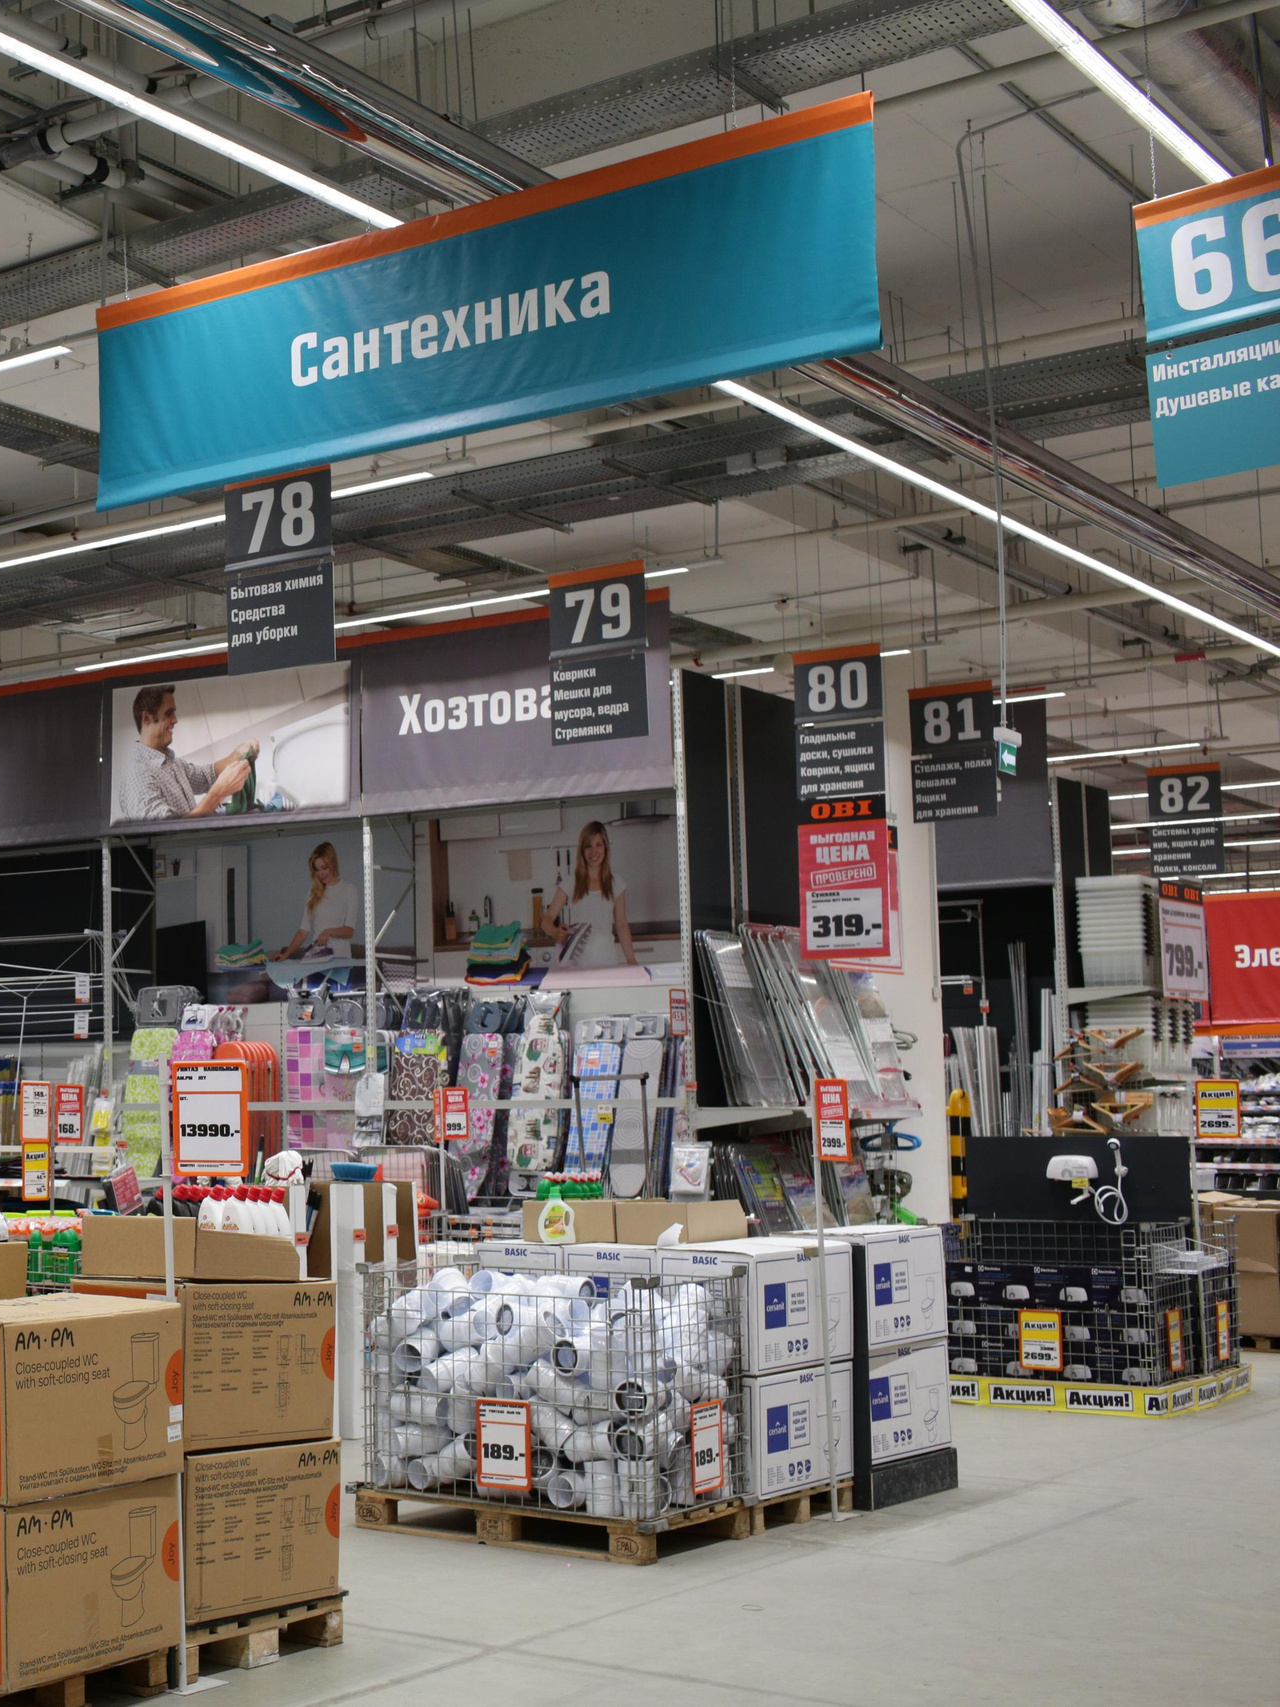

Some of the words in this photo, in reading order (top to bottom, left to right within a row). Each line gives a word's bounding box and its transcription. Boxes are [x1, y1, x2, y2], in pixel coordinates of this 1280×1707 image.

[1171, 198, 1280, 312] 66
[290, 269, 610, 388] Сантехника
[1156, 379, 1251, 418] Душевые
[242, 481, 315, 554] 78
[231, 581, 282, 600] Бытовая
[285, 574, 324, 592] химия
[231, 604, 285, 624] Средства
[565, 583, 632, 644] 79
[231, 632, 253, 648] для
[256, 624, 298, 645] уборки
[553, 667, 596, 682] Коврики
[554, 686, 591, 702] Мешки
[593, 684, 612, 699] для
[808, 661, 868, 713] 80
[554, 704, 595, 721] мусора,
[598, 702, 629, 716] ведра
[923, 697, 981, 744] 81
[555, 723, 613, 740] Стремянки
[800, 731, 856, 745] Гладильные
[800, 750, 830, 762] доски,
[832, 746, 874, 759] сушилки
[801, 765, 843, 778] Коврики,
[844, 762, 875, 774] ящики
[914, 761, 963, 774] Стеллажи,
[964, 758, 992, 769] полки
[801, 783, 818, 795] для
[820, 780, 864, 793] хранения
[915, 777, 957, 789] Вешалки
[916, 793, 947, 804] Ящики
[1160, 775, 1210, 814] 82
[810, 800, 872, 820] OBI
[916, 810, 933, 820] для
[935, 805, 979, 818] хранения
[809, 830, 876, 845] ВЫГОДНАЯ
[1152, 826, 1190, 837] Системы
[1171, 839, 1198, 849] ящики
[1199, 838, 1215, 848] для
[816, 844, 870, 865] ЦЕНА
[1153, 852, 1191, 861] хранения
[815, 866, 873, 885] ПРОВЕРЕНО
[1183, 863, 1217, 872] консоли
[1162, 883, 1178, 897] OBI
[1184, 887, 1200, 901] OBI
[1234, 944, 1280, 968] Эле
[1201, 1090, 1234, 1099] Акция!
[898, 1234, 910, 1244] BASIC
[505, 1248, 528, 1257] BASIC
[596, 1251, 621, 1261] BASIC
[692, 1255, 718, 1266] BASIC
[766, 1302, 785, 1312] cersanit
[1024, 1321, 1057, 1330] Акция!
[15, 1355, 80, 1376] Close-coupled
[82, 1353, 98, 1366] WC
[16, 1376, 36, 1390] with
[38, 1370, 90, 1388] soft-closing
[92, 1367, 110, 1381] seat
[800, 1373, 814, 1384] BASIC
[993, 1386, 1051, 1404] Акция!
[1069, 1391, 1130, 1409] Акция!
[768, 1425, 787, 1436] cersanit
[16, 1535, 80, 1561] Close-coupled
[81, 1532, 97, 1546] WC
[16, 1562, 37, 1576] with
[38, 1551, 89, 1570] soft-closing
[90, 1545, 109, 1560] seat
